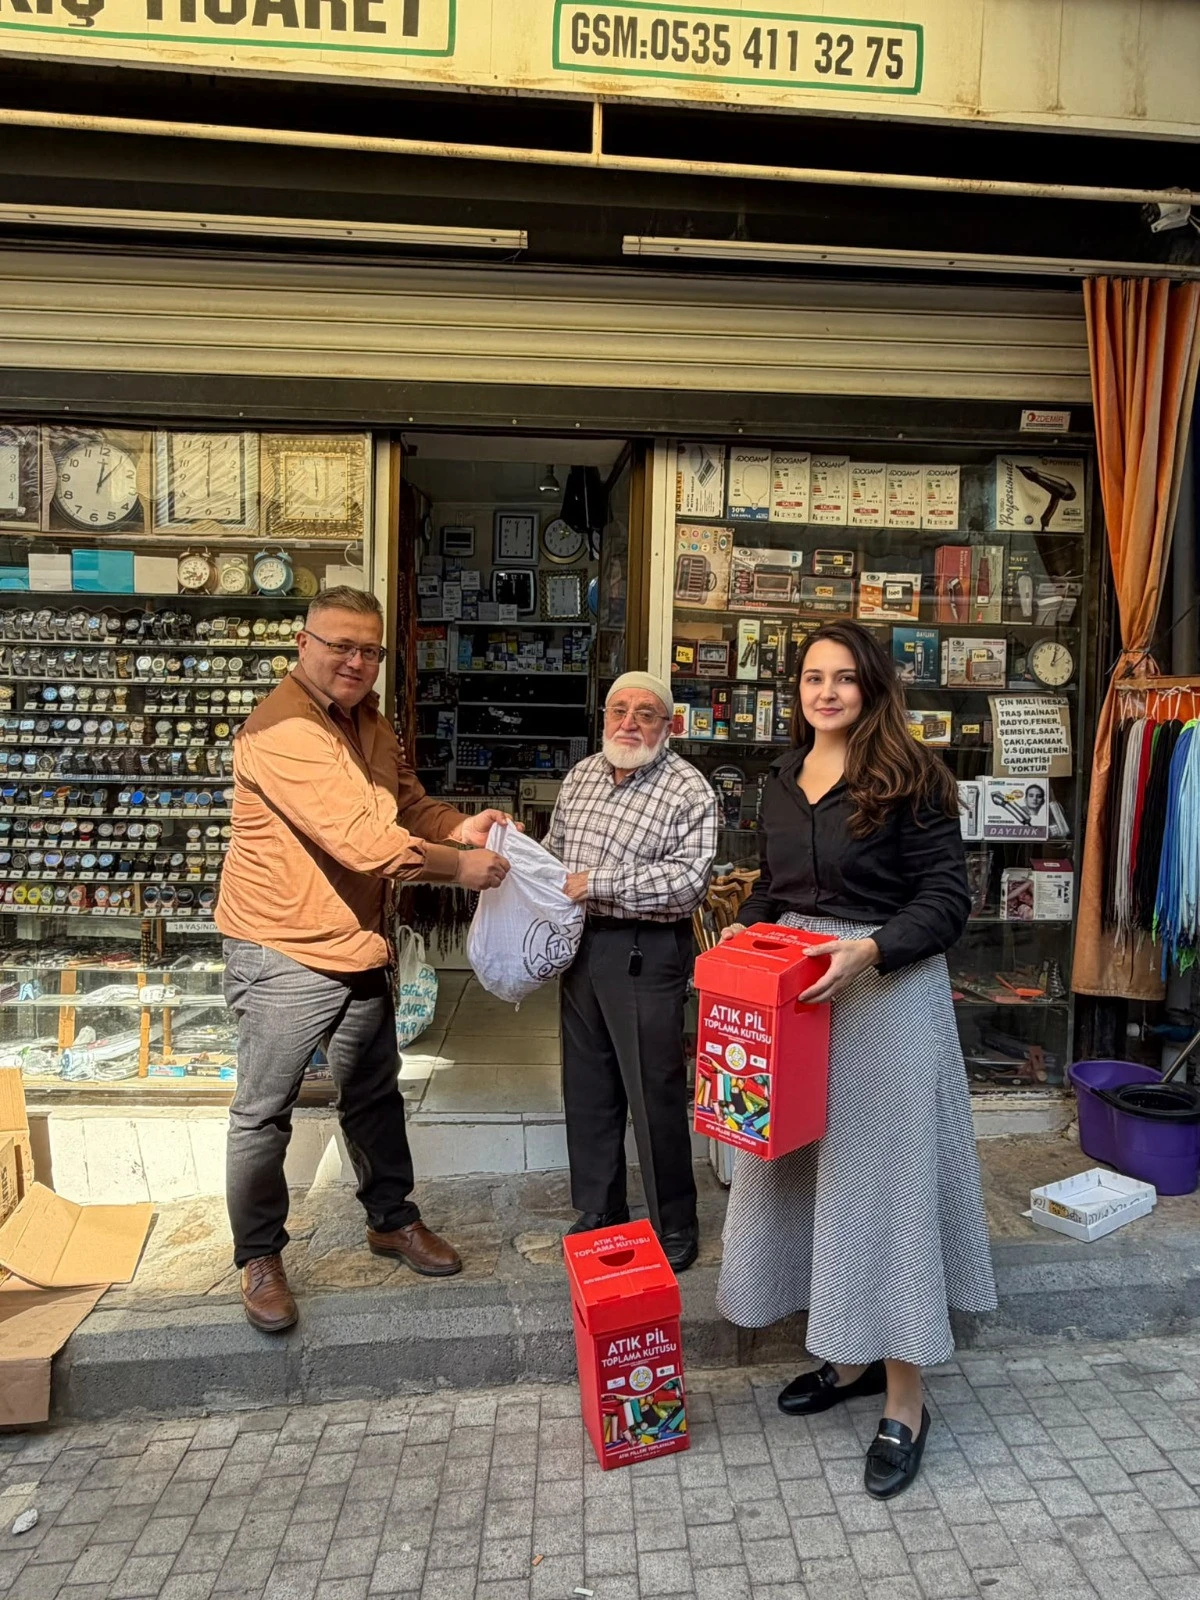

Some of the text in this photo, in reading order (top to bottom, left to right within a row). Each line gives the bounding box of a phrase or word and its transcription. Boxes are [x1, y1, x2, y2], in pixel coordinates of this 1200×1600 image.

[571, 11, 904, 79] GSM:0535 411 32 75
[84, 449, 92, 458] 11
[99, 447, 111, 456] 12
[69, 458, 79, 467] 10
[61, 474, 71, 482] 9
[126, 470, 134, 479] 2
[63, 491, 73, 499] 8
[999, 458, 1019, 526] Professional
[75, 505, 82, 514] 7
[121, 503, 129, 511] 4
[89, 513, 99, 522] 6
[107, 511, 116, 520] 5
[999, 699, 1014, 707] ÇİN
[1019, 746, 1068, 754] ÜRÜNLERİN
[990, 827, 1039, 836] DAYLINK
[186, 923, 218, 931] YAŞIND
[709, 1004, 766, 1032] ATIK PİL
[703, 1017, 772, 1045] TOPLAMA KUTUSU
[593, 1234, 628, 1247] ATIK PİL
[573, 1236, 650, 1258] TOPLAMA KUTUSU
[607, 1327, 669, 1356] ATIK PİL
[601, 1343, 677, 1368] TOPLAMA KUTUSU
